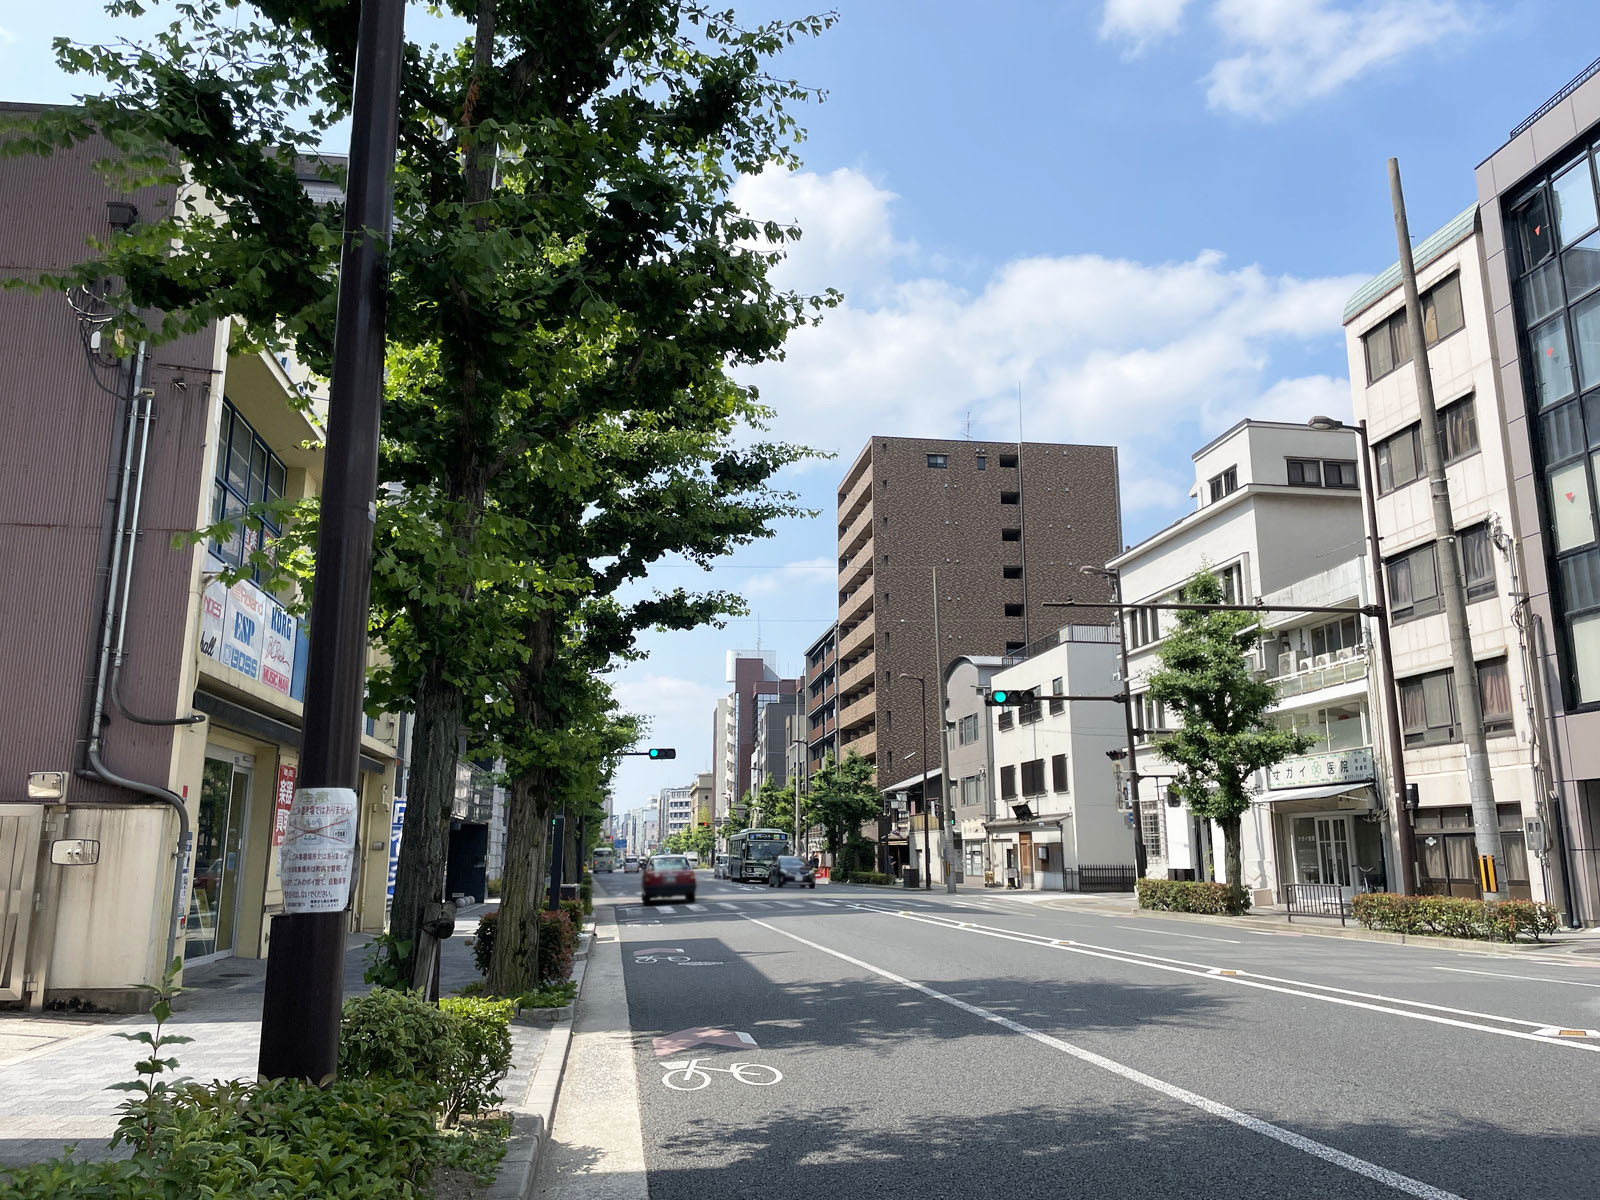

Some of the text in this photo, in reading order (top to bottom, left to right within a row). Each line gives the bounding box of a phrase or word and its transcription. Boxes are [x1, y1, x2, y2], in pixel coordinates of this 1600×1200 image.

[234, 611, 255, 647] ESP
[271, 605, 292, 641] KORG
[231, 648, 258, 679] BOSS
[263, 667, 288, 693] MUSIC MAN
[1327, 760, 1348, 774] 医院
